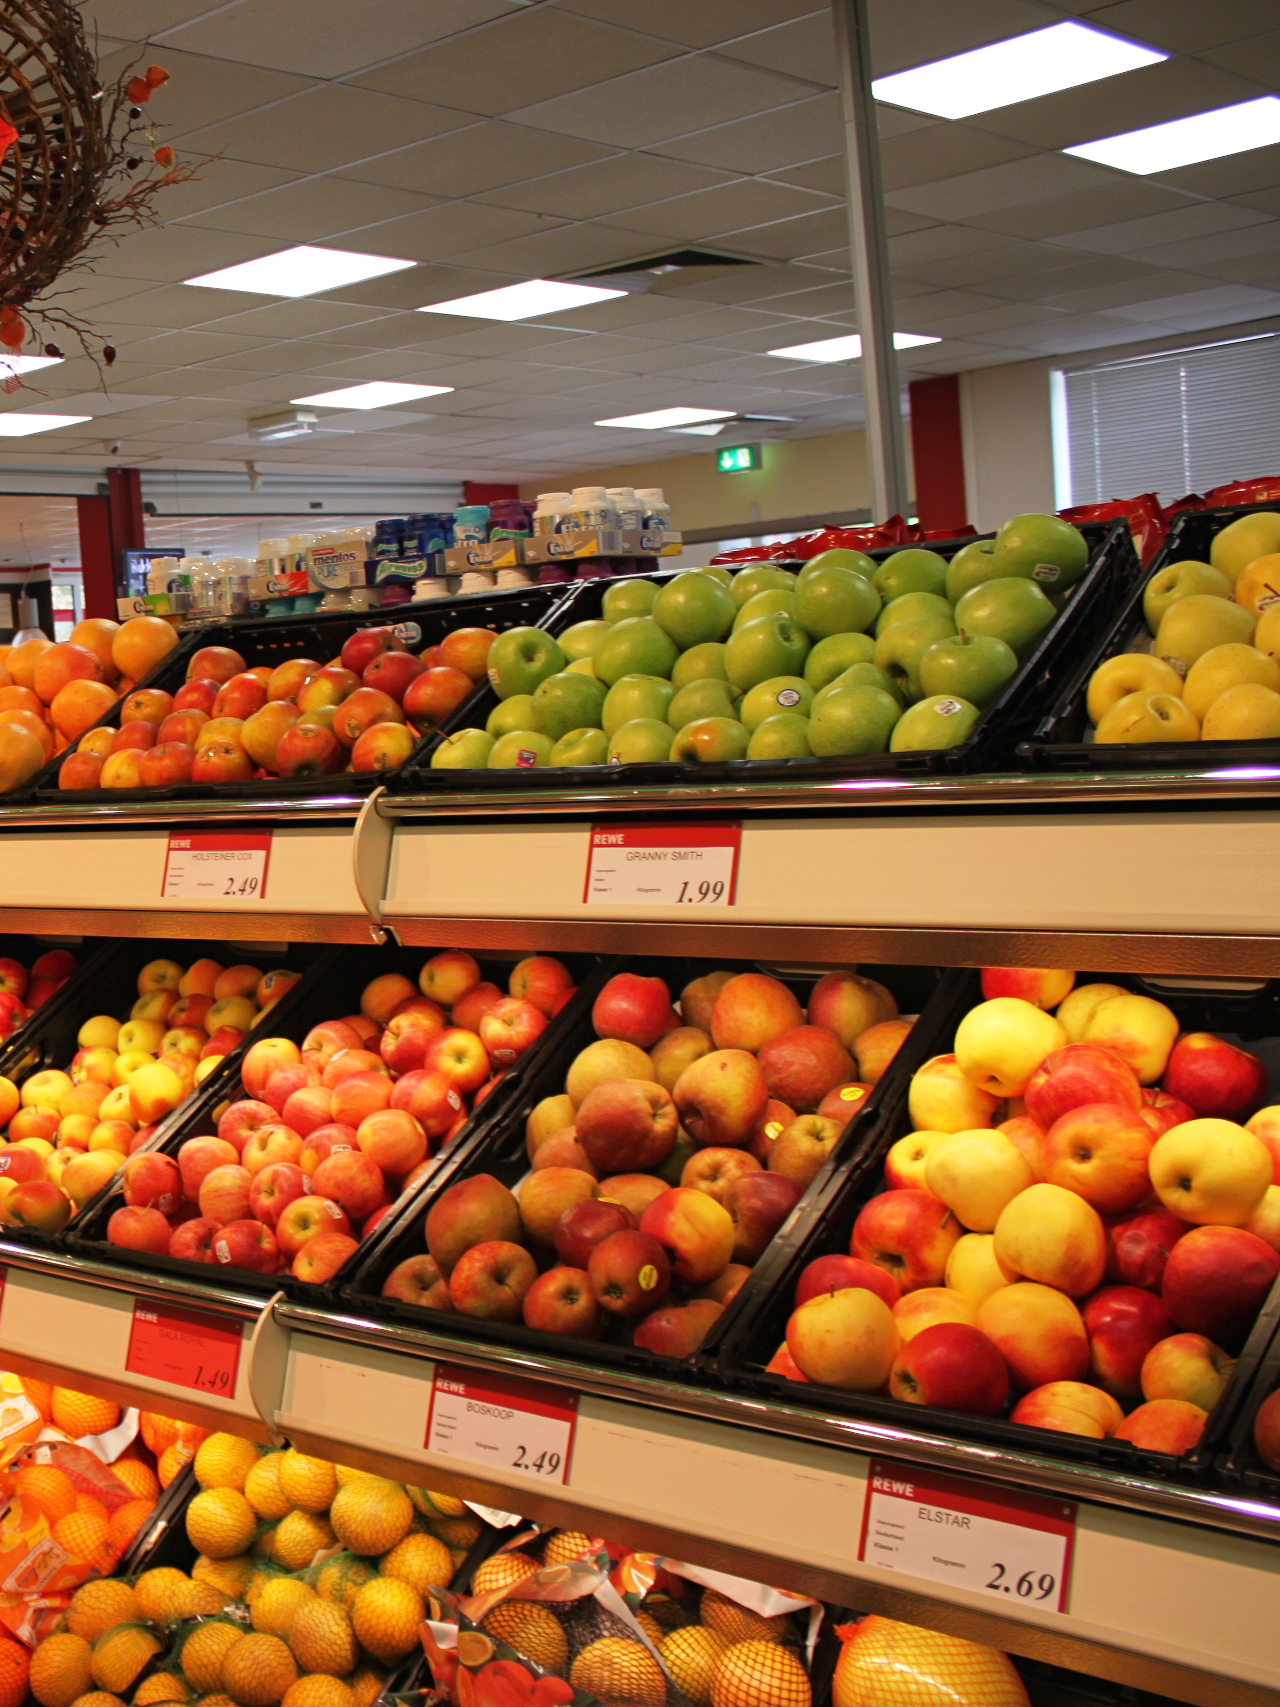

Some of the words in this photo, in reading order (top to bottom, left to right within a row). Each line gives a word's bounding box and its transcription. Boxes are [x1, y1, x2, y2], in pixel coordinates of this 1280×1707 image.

[313, 552, 356, 566] mentos
[170, 839, 191, 849] REWE
[593, 834, 625, 845] REWE
[191, 852, 235, 861] HOLSTEINER
[237, 852, 253, 861] COX
[626, 851, 669, 861] GRANNY
[671, 851, 703, 861] SMITH
[223, 877, 258, 896] 2.49
[675, 880, 725, 904] 1.99
[135, 1309, 158, 1323] REWE
[194, 1366, 230, 1390] 1.49
[435, 1378, 466, 1394] REWE
[466, 1401, 515, 1420] BOSKOOP
[512, 1445, 561, 1475] 2.49
[872, 1475, 915, 1497] REWE
[918, 1507, 971, 1530] ELSTAR
[932, 1556, 966, 1569] Kilogramm
[985, 1562, 1055, 1600] 2.69
